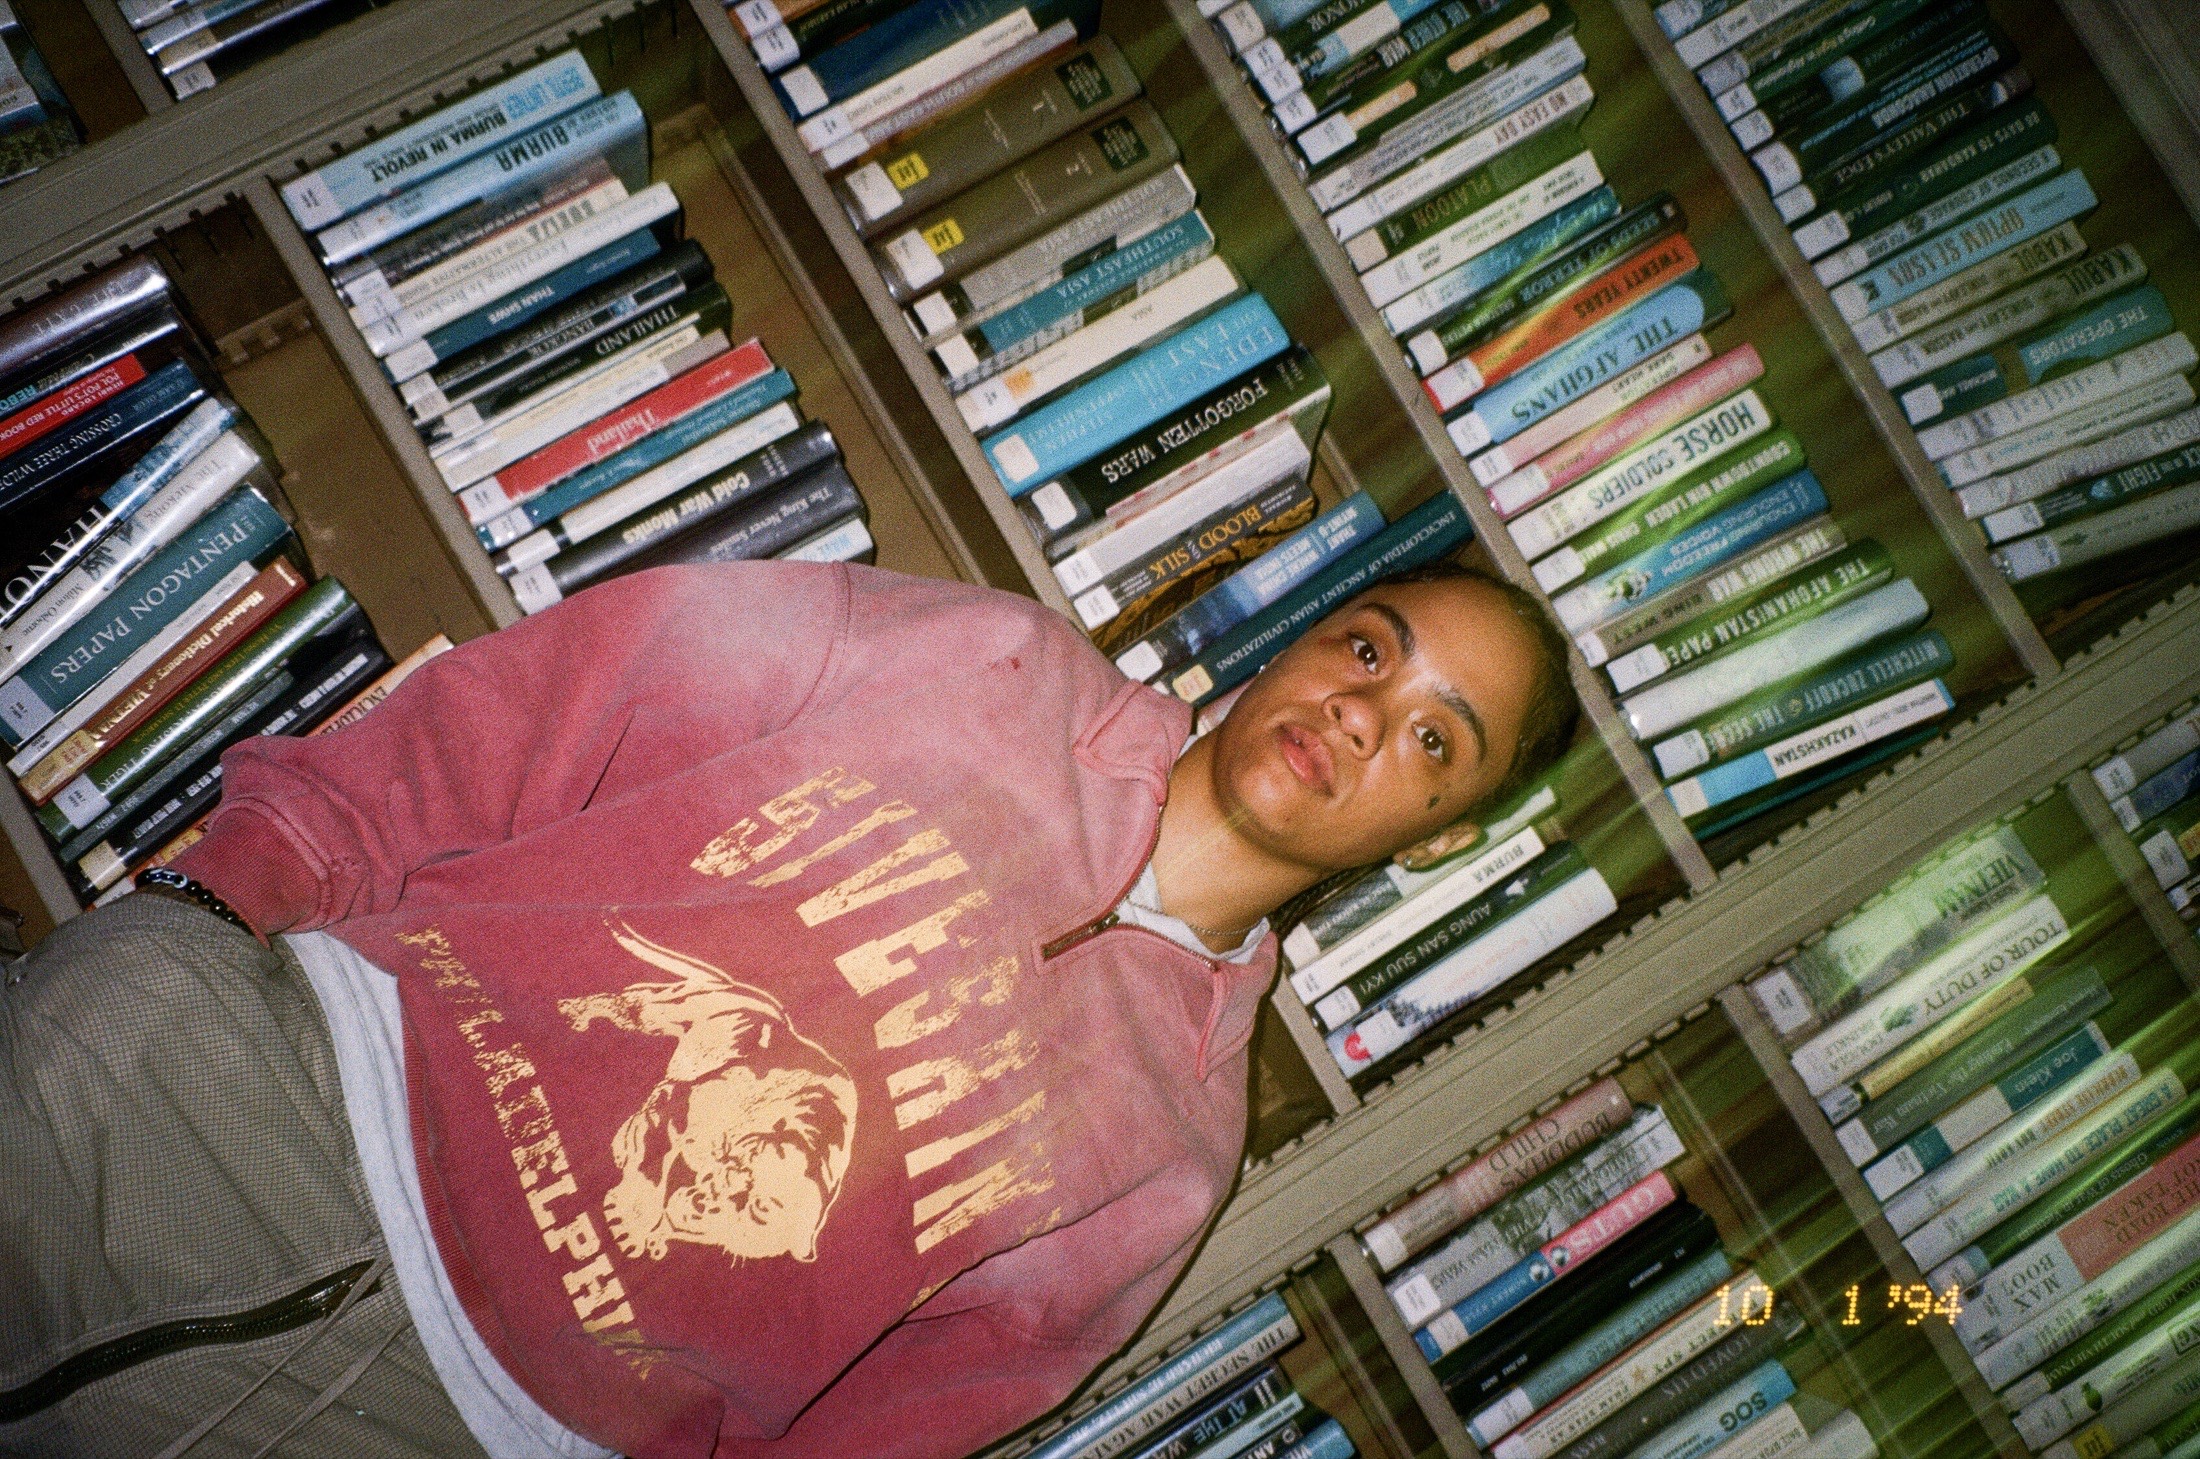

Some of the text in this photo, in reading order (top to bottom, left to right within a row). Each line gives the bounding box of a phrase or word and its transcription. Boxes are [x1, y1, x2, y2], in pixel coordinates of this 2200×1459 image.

[1932, 45, 2000, 93] OPERATION
[1869, 80, 1938, 129] ANACONDA
[1934, 101, 1968, 128] THE
[428, 136, 448, 156] IN
[448, 109, 506, 146] BURMA
[494, 123, 569, 173] BURMA
[1872, 118, 1937, 162] VALLEY'S
[369, 146, 428, 184] REVOLT
[1832, 153, 1874, 185] EDGE
[526, 197, 594, 243] BURMA
[1035, 176, 1166, 254] SOUTHEAST ASIA
[1409, 172, 1493, 232] PLATOON
[1608, 211, 1660, 251] SEEDS
[2009, 230, 2072, 275] KABUL
[1055, 222, 1184, 299] SOUTHEAST ASIA
[1517, 255, 1586, 304] TERROR
[1572, 245, 1683, 319] TWENTY YEARS
[2056, 246, 2133, 300] KABUL
[412, 288, 468, 326] Broken
[518, 281, 555, 309] THAN
[526, 316, 596, 359] BANGKOK
[593, 303, 679, 357] THAILAND
[1163, 321, 1230, 368] EAST
[1197, 323, 1275, 378] EDEN
[2026, 304, 2147, 365] THE OPERATORS
[71, 380, 101, 401] POT'S
[98, 369, 120, 386] POL
[1507, 312, 1680, 426] THE AFGHANS
[24, 410, 46, 427] RED
[43, 394, 75, 417] LITTLE
[60, 377, 124, 418] HENRI LOCARD
[1152, 375, 1267, 454] FORGOTTEN
[31, 409, 124, 469] CROSSING THREE
[584, 404, 659, 457] Thailand
[1671, 400, 1755, 464] HORSE
[1098, 440, 1156, 485] WARS
[1586, 446, 1675, 511] SOLDIERS
[2115, 461, 2161, 493] FIGHT
[619, 469, 750, 548] Cold War Monks
[779, 496, 808, 520] King
[806, 484, 831, 505] The
[746, 510, 781, 537] Never
[1196, 502, 1262, 552] BLOOD
[1325, 524, 1356, 550] THANT
[1148, 544, 1191, 581] SILK
[1659, 535, 1728, 576] FREEDOM
[48, 518, 249, 685] PENTAGON PAPERS
[53, 581, 85, 612] Milton
[1214, 510, 1456, 672] ENCYCLOPEDIA OF ANCIENT ASIAN CIVILIZATIONS
[1713, 556, 1869, 642] THE AFGHANISTAN
[153, 588, 264, 681] Historical Dictionary
[1801, 639, 1939, 712] MITCHELL ZUCKOFF
[1753, 705, 1784, 731] THE
[1772, 723, 1858, 767] KAZAKHSTAN
[99, 755, 140, 792] TIGER
[1471, 843, 1524, 884] BURMA
[1932, 848, 2025, 918] VIETNAM
[1448, 901, 1492, 936] AUNG
[1384, 950, 1416, 977] SUU
[1416, 928, 1449, 957] SAN
[1357, 970, 1384, 994] KYI
[1918, 918, 2061, 1016] TOUR OF DUTY
[2012, 1045, 2081, 1097] Joe Klein
[2119, 1091, 2161, 1127] GREAT
[1485, 1117, 1562, 1174] CHILD
[1496, 1111, 1612, 1191] BUDDHA'S
[2063, 1143, 2083, 1164] TO
[2082, 1118, 2121, 1152] PLACE
[2030, 1155, 2065, 1186] HAVE
[2095, 1172, 2115, 1193] of
[2112, 1150, 2150, 1182] Ghosts
[2072, 1183, 2099, 1208] War
[2101, 1181, 2167, 1232] TAKEN
[1565, 1186, 1658, 1255] GUTS
[2016, 1207, 2063, 1244] Vietnam
[2112, 1201, 2168, 1246] ROAD
[2011, 1272, 2061, 1314] MAX
[1139, 1324, 1290, 1429] THE SECRET WAR
[1649, 1348, 1685, 1376] SPY
[1688, 1332, 1751, 1382] LOVED
[1190, 1398, 1249, 1447] AT THE
[1717, 1389, 1769, 1433] SOG
